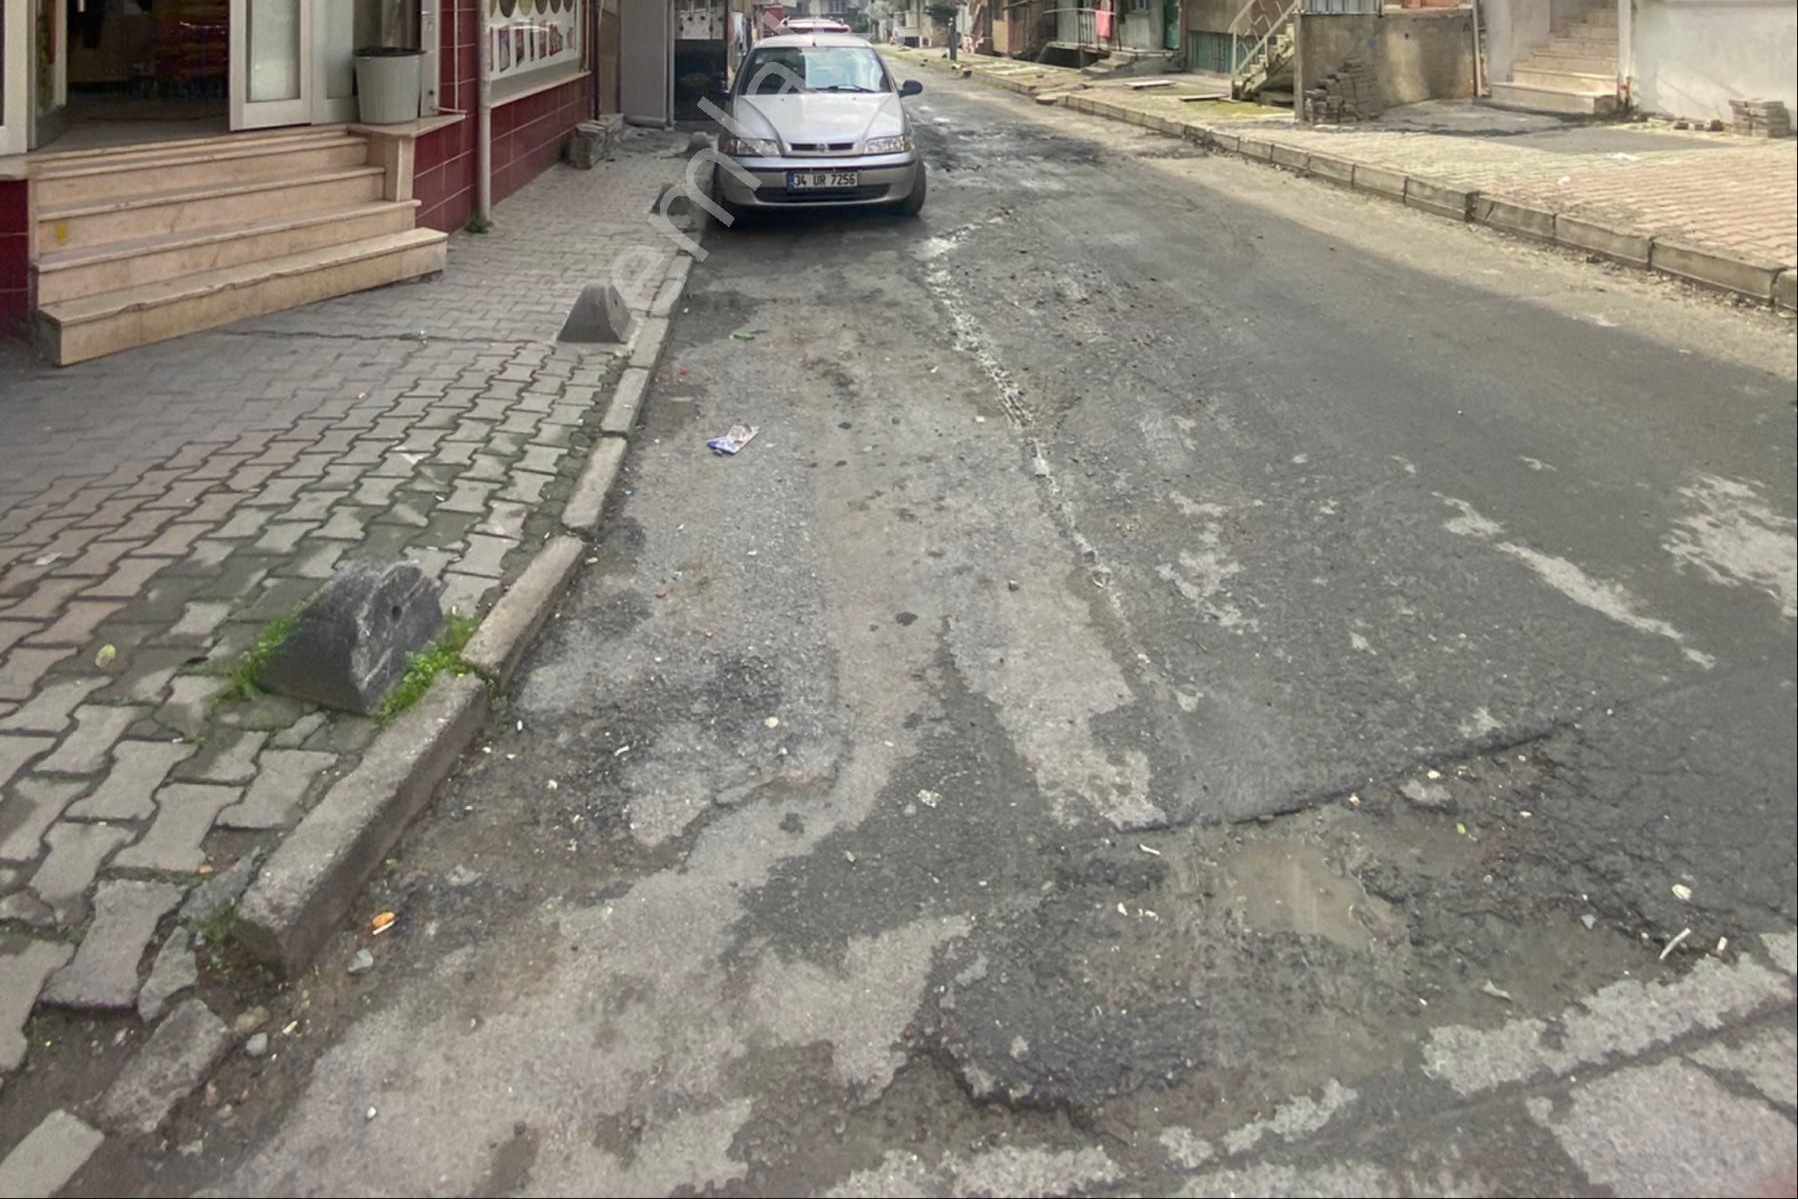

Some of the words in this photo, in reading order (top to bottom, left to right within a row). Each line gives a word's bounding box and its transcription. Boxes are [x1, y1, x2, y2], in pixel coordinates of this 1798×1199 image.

[795, 174, 807, 187] 34
[813, 174, 826, 186] UR
[831, 173, 856, 186] 7256
